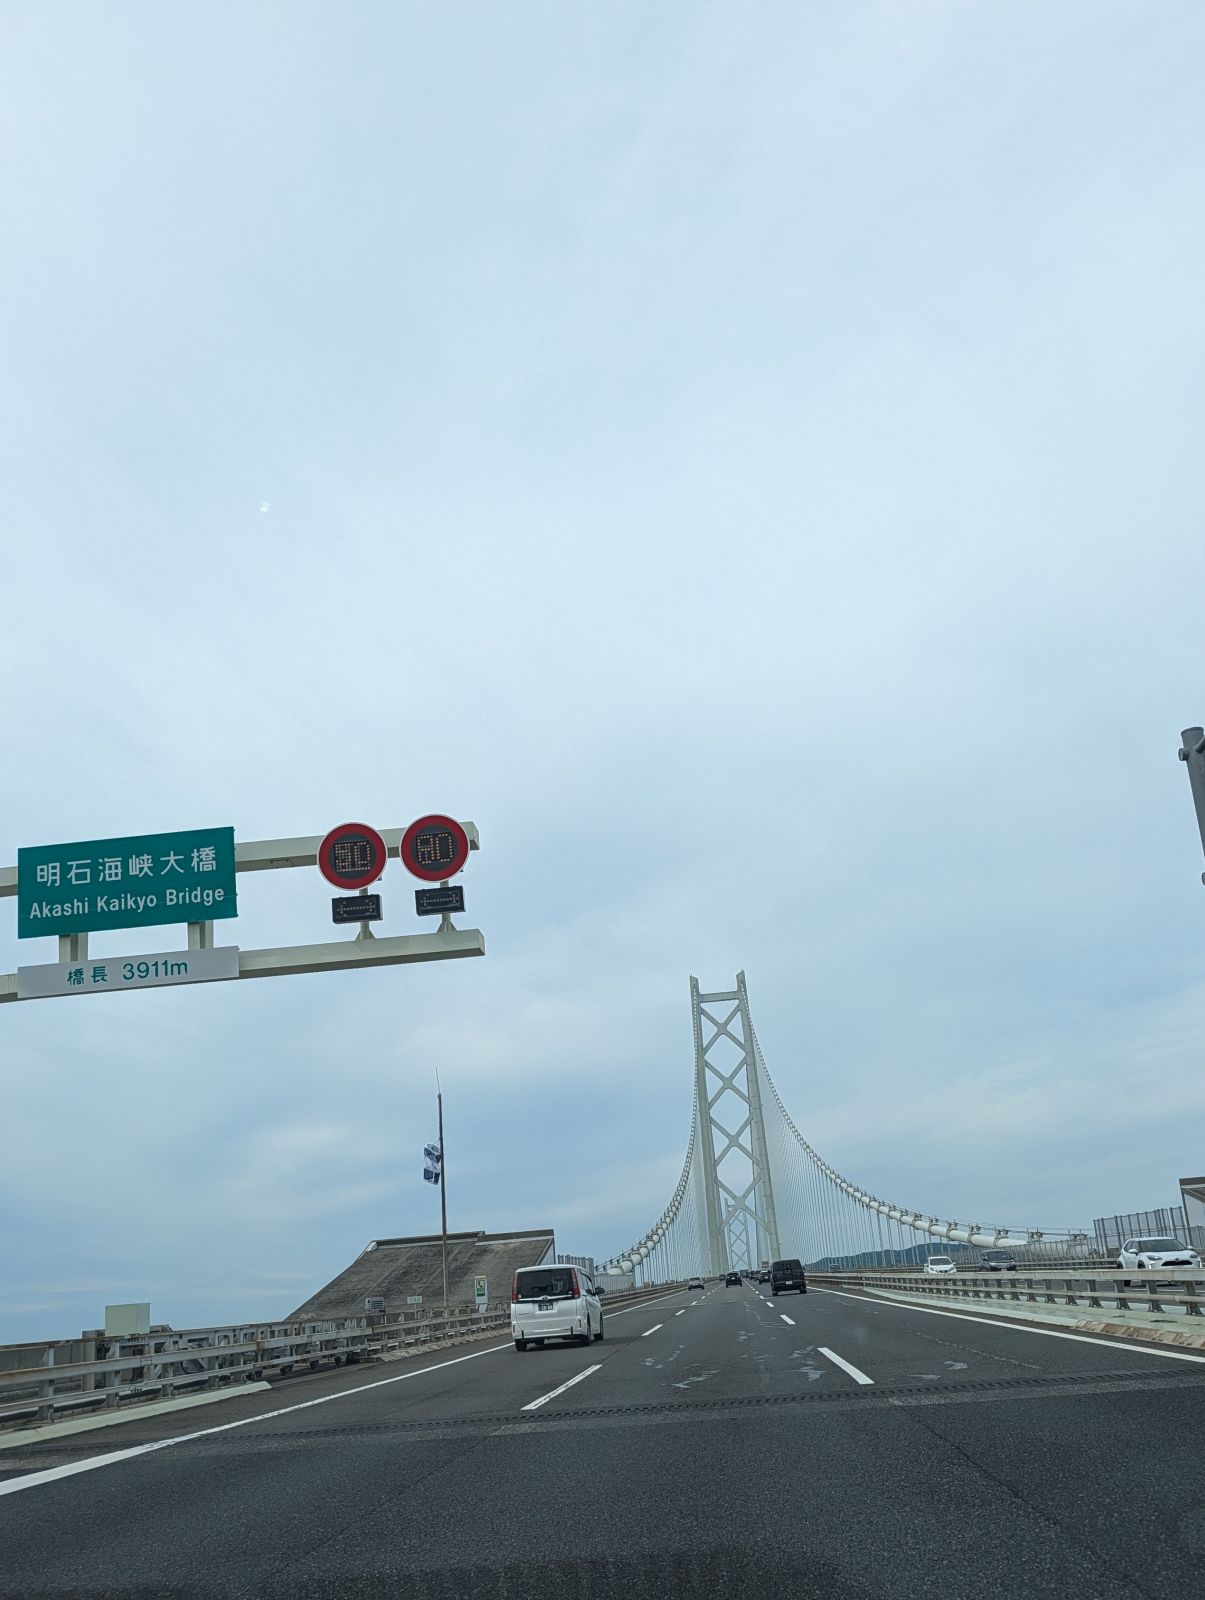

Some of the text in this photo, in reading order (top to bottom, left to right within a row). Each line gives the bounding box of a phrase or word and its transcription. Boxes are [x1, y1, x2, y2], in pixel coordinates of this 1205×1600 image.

[36, 846, 217, 887] 明石海峡大橋
[29, 888, 225, 919] Akashi Kaikyo Bridge
[66, 959, 188, 986] 橋長 3911m
